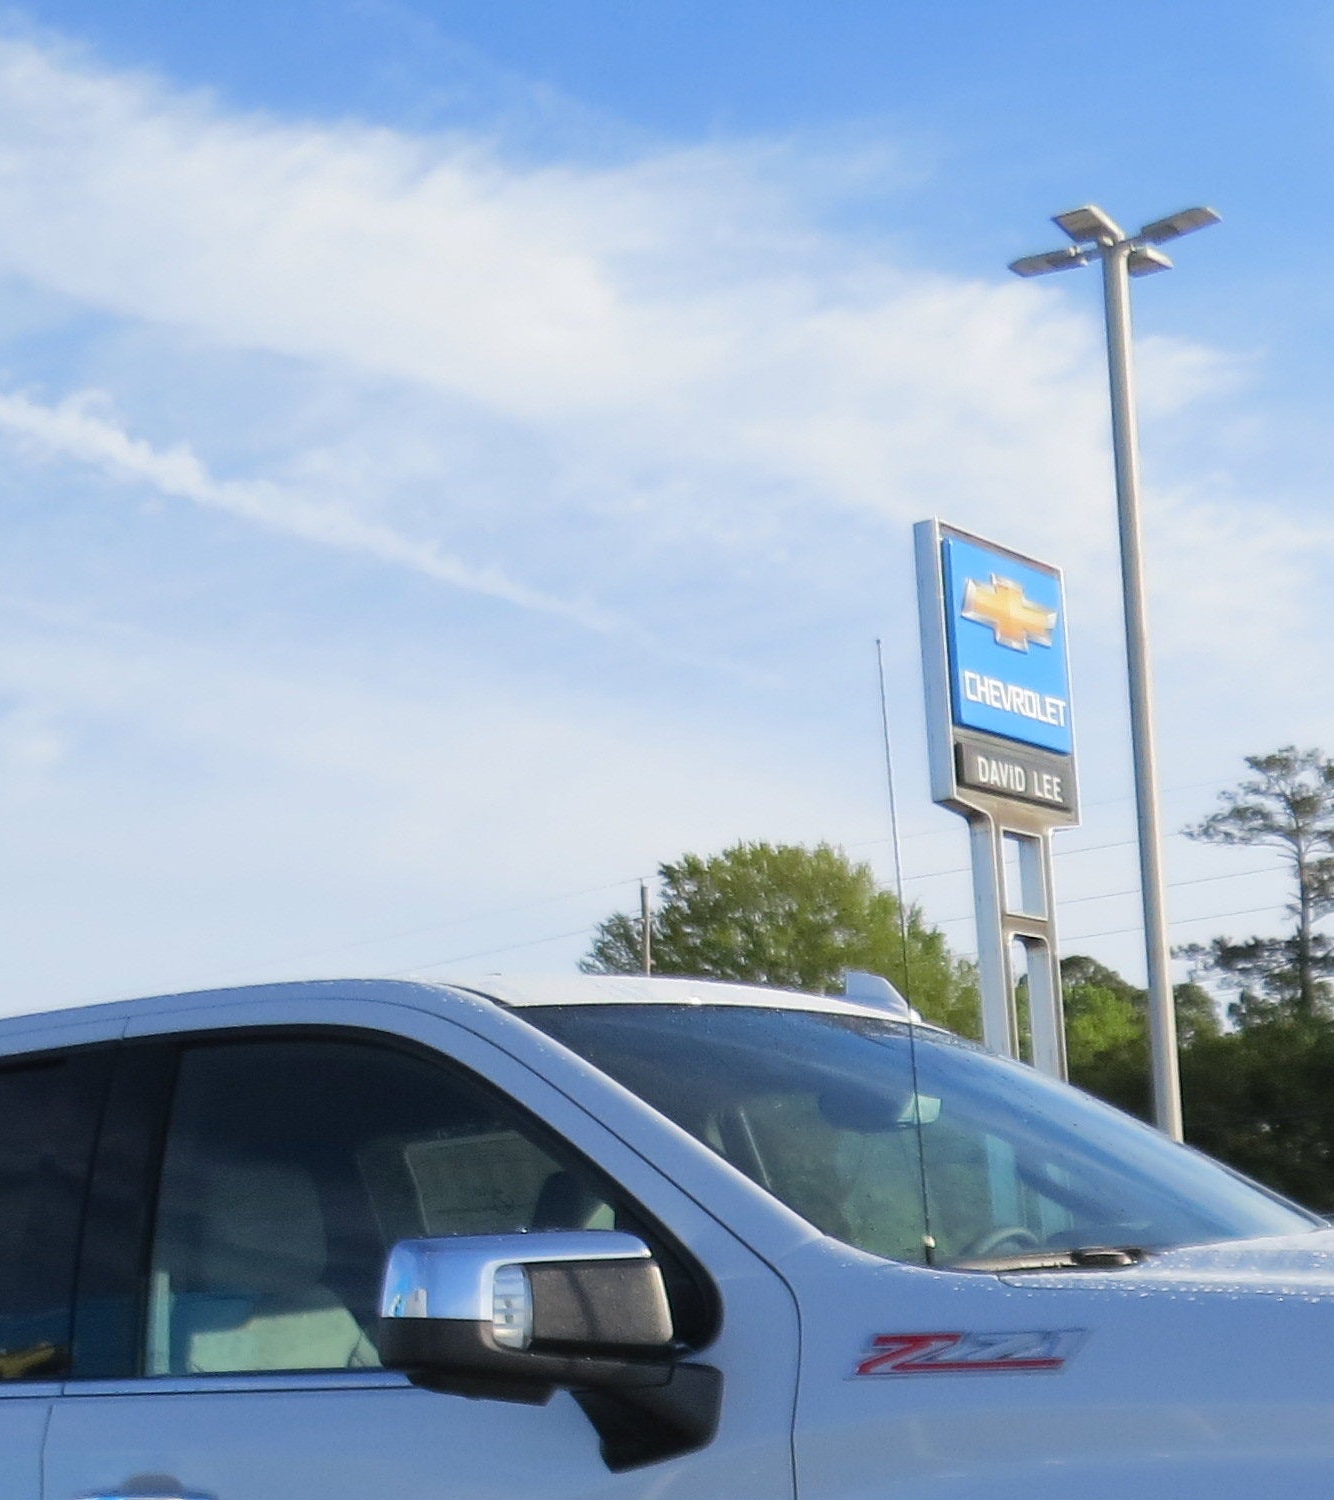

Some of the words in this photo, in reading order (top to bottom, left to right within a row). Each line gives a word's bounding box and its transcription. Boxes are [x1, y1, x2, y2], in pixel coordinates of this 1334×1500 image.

[964, 671, 1066, 728] CHEVROLET
[977, 757, 1026, 792] DAVID
[1033, 772, 1063, 802] LEE
